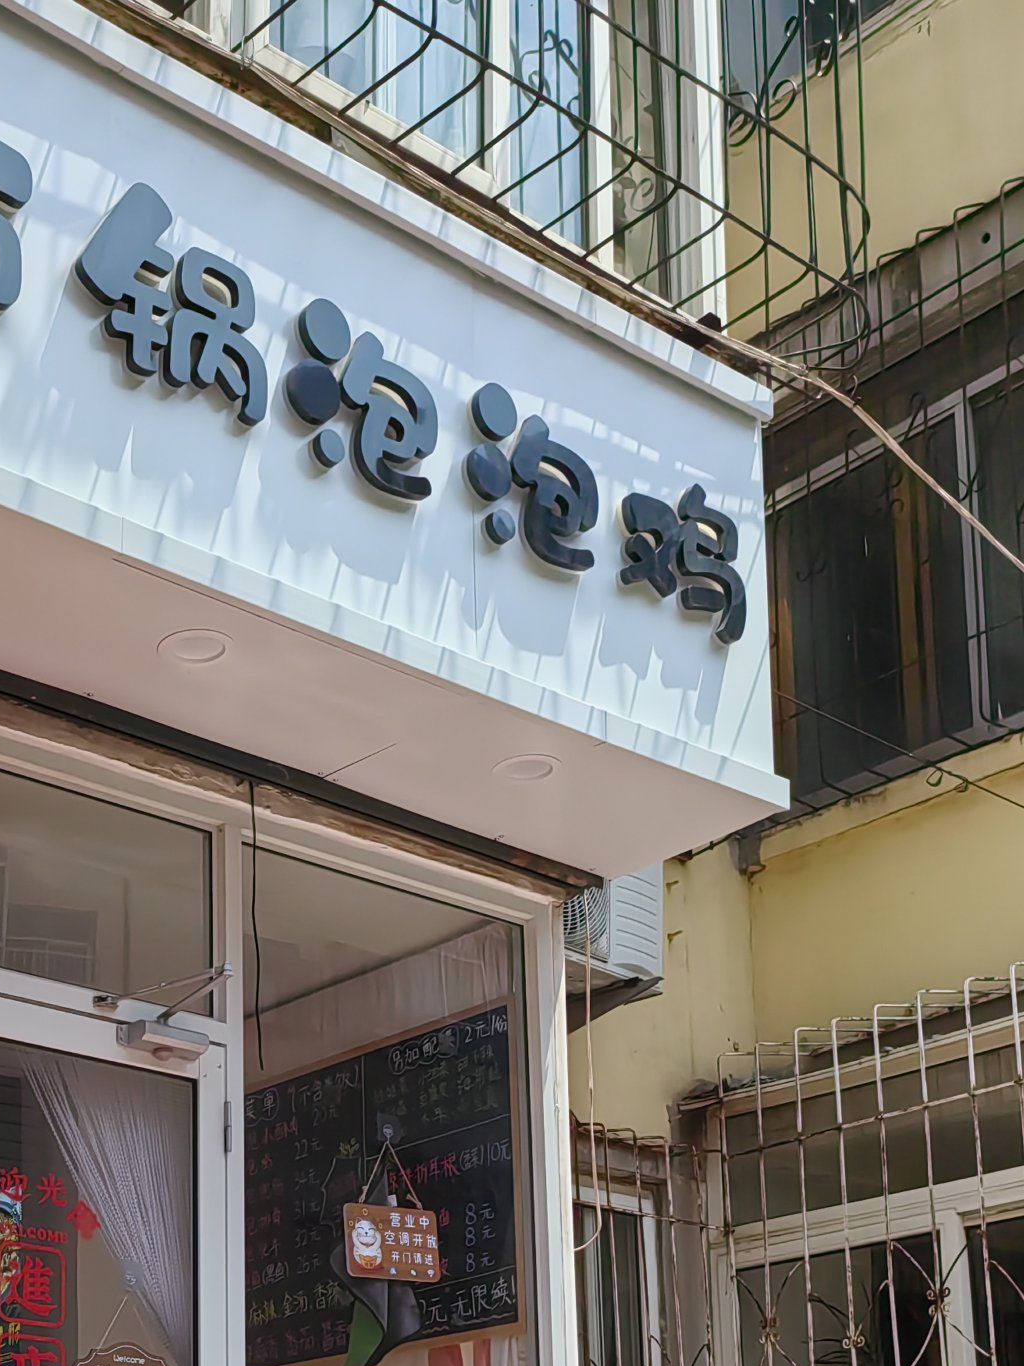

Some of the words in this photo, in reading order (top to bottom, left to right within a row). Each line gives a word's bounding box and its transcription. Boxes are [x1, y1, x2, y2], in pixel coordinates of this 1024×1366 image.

[389, 1212, 430, 1230] 营业中
[384, 1231, 439, 1250] 空调开放
[391, 1251, 435, 1267] 开门请进
[113, 1354, 146, 1365] Welcome
